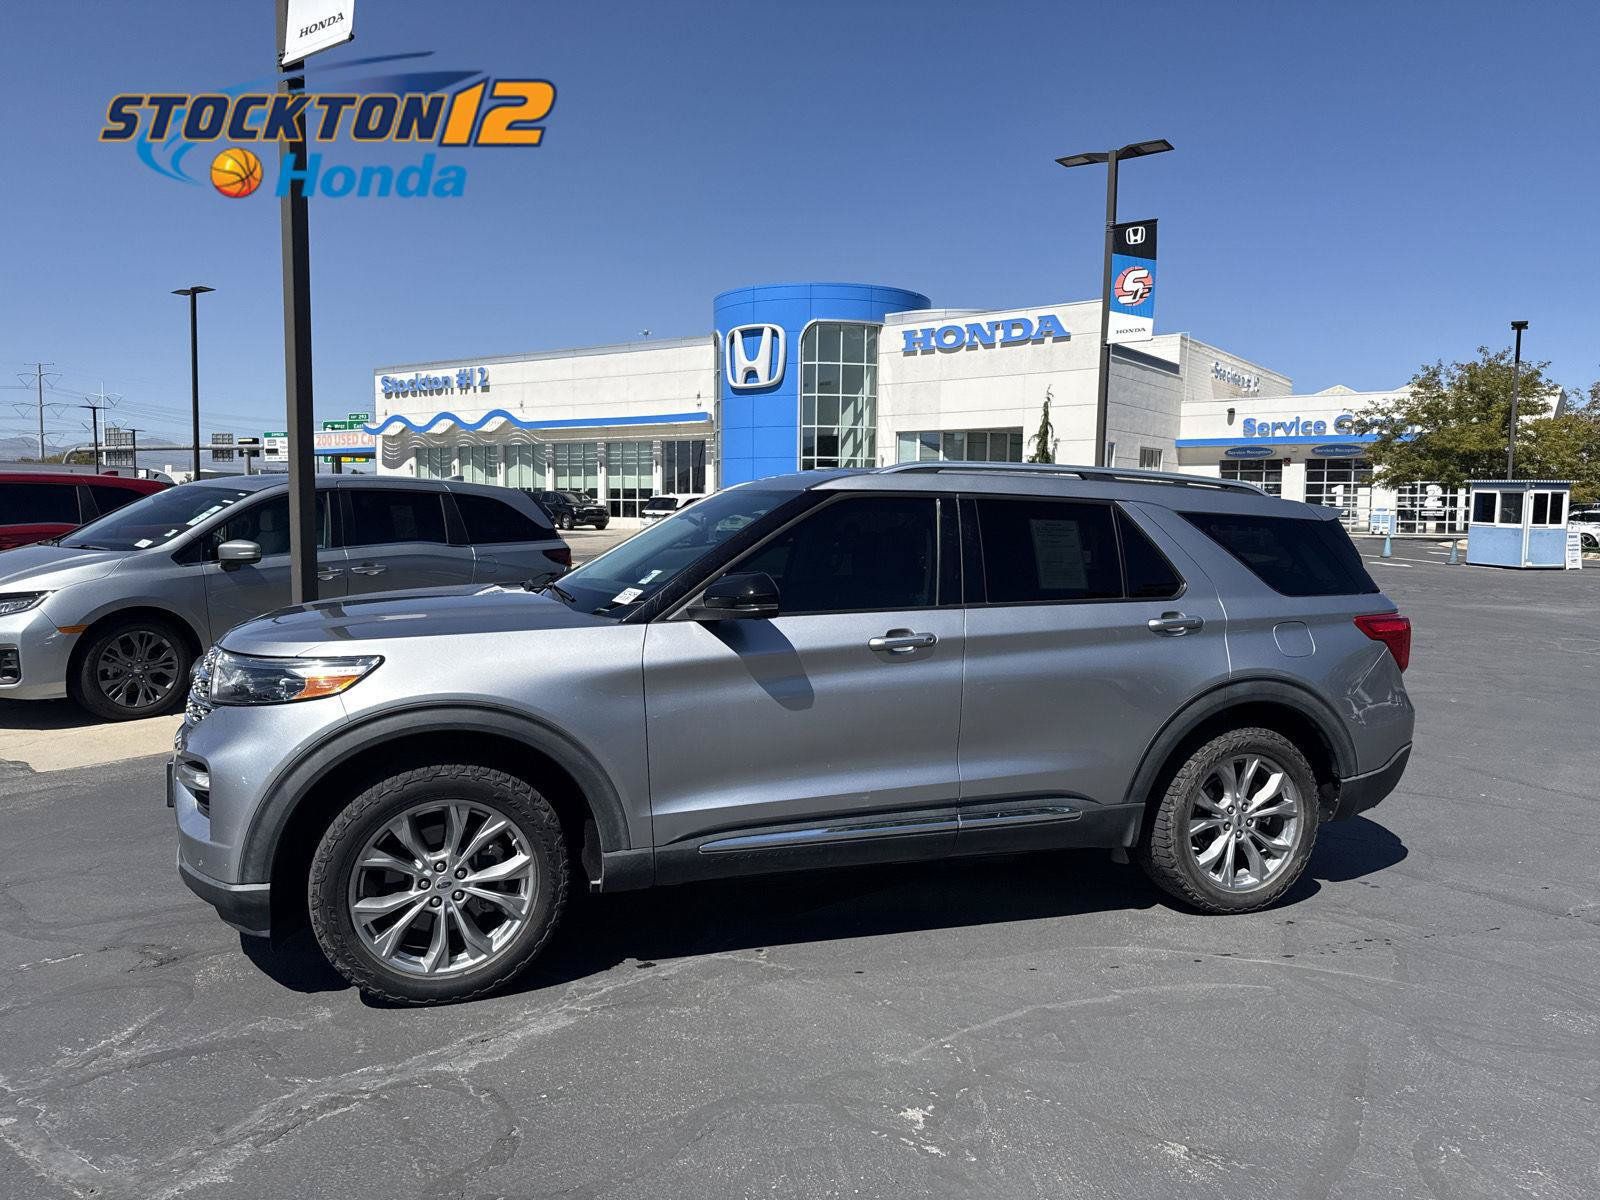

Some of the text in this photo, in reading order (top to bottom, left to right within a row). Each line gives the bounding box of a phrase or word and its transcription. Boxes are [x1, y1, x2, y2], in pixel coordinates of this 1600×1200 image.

[299, 12, 345, 38] HONDA
[902, 315, 1070, 355] HONDA
[1115, 327, 1147, 335] HONDA
[381, 373, 453, 394] Stockton
[1243, 416, 1327, 437] Service
[334, 434, 359, 446] USED
[1424, 484, 1443, 507] 2
